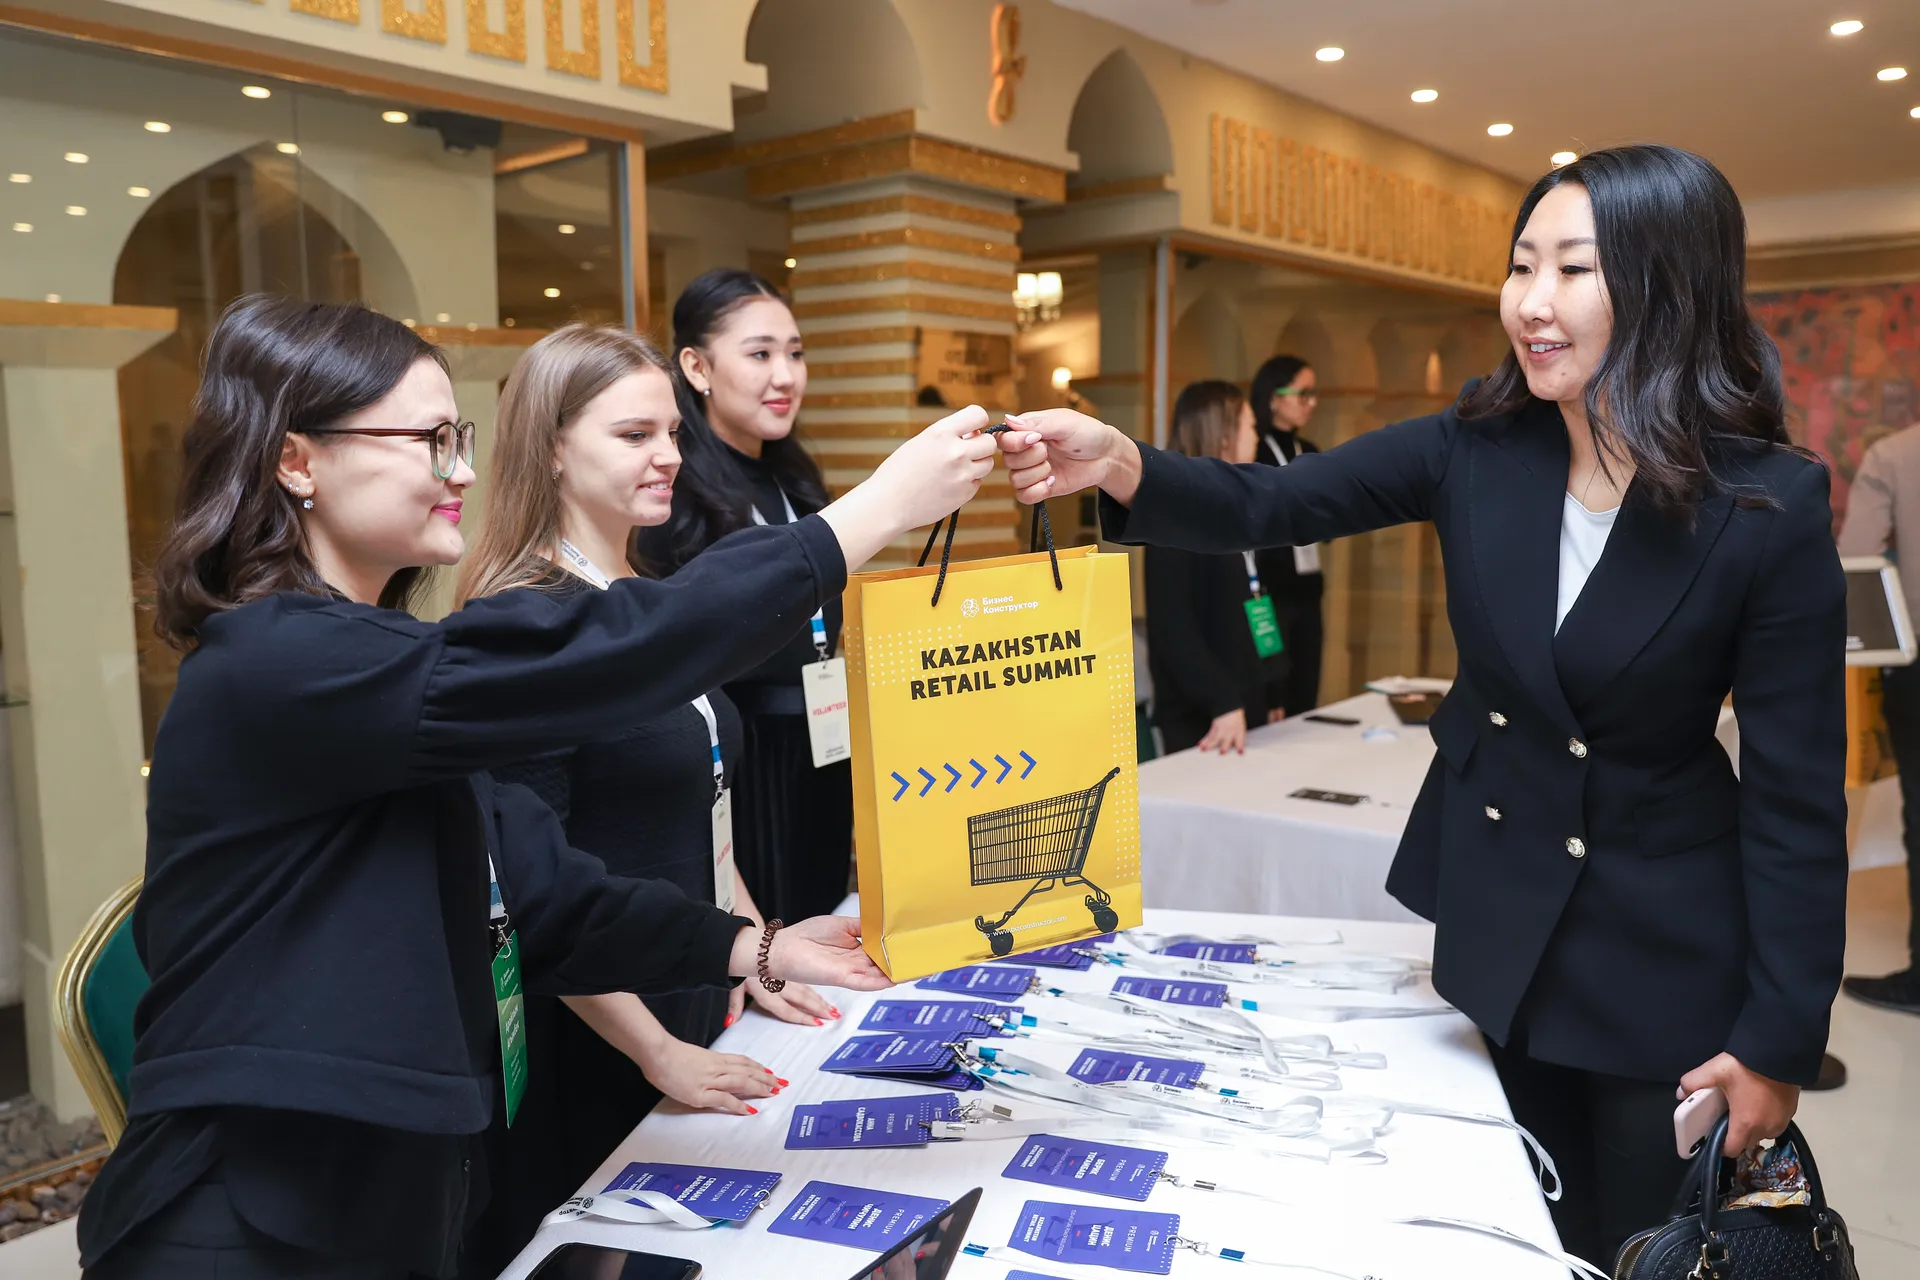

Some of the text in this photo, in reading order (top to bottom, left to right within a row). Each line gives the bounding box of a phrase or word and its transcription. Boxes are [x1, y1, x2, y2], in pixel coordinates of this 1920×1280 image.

[982, 595, 1014, 605] Бизнес
[983, 600, 1039, 614] Конструктор
[921, 629, 1082, 670] KAZAKHSTAN
[910, 655, 1097, 700] RETAIL SUMMIT
[848, 1204, 874, 1229] ЧИЧУЛИН
[863, 1208, 882, 1228] ДЕНИС
[882, 1209, 905, 1234] PREMIUM
[1101, 1226, 1114, 1247] ДЕНИС
[1124, 1226, 1137, 1252] PREMIUM
